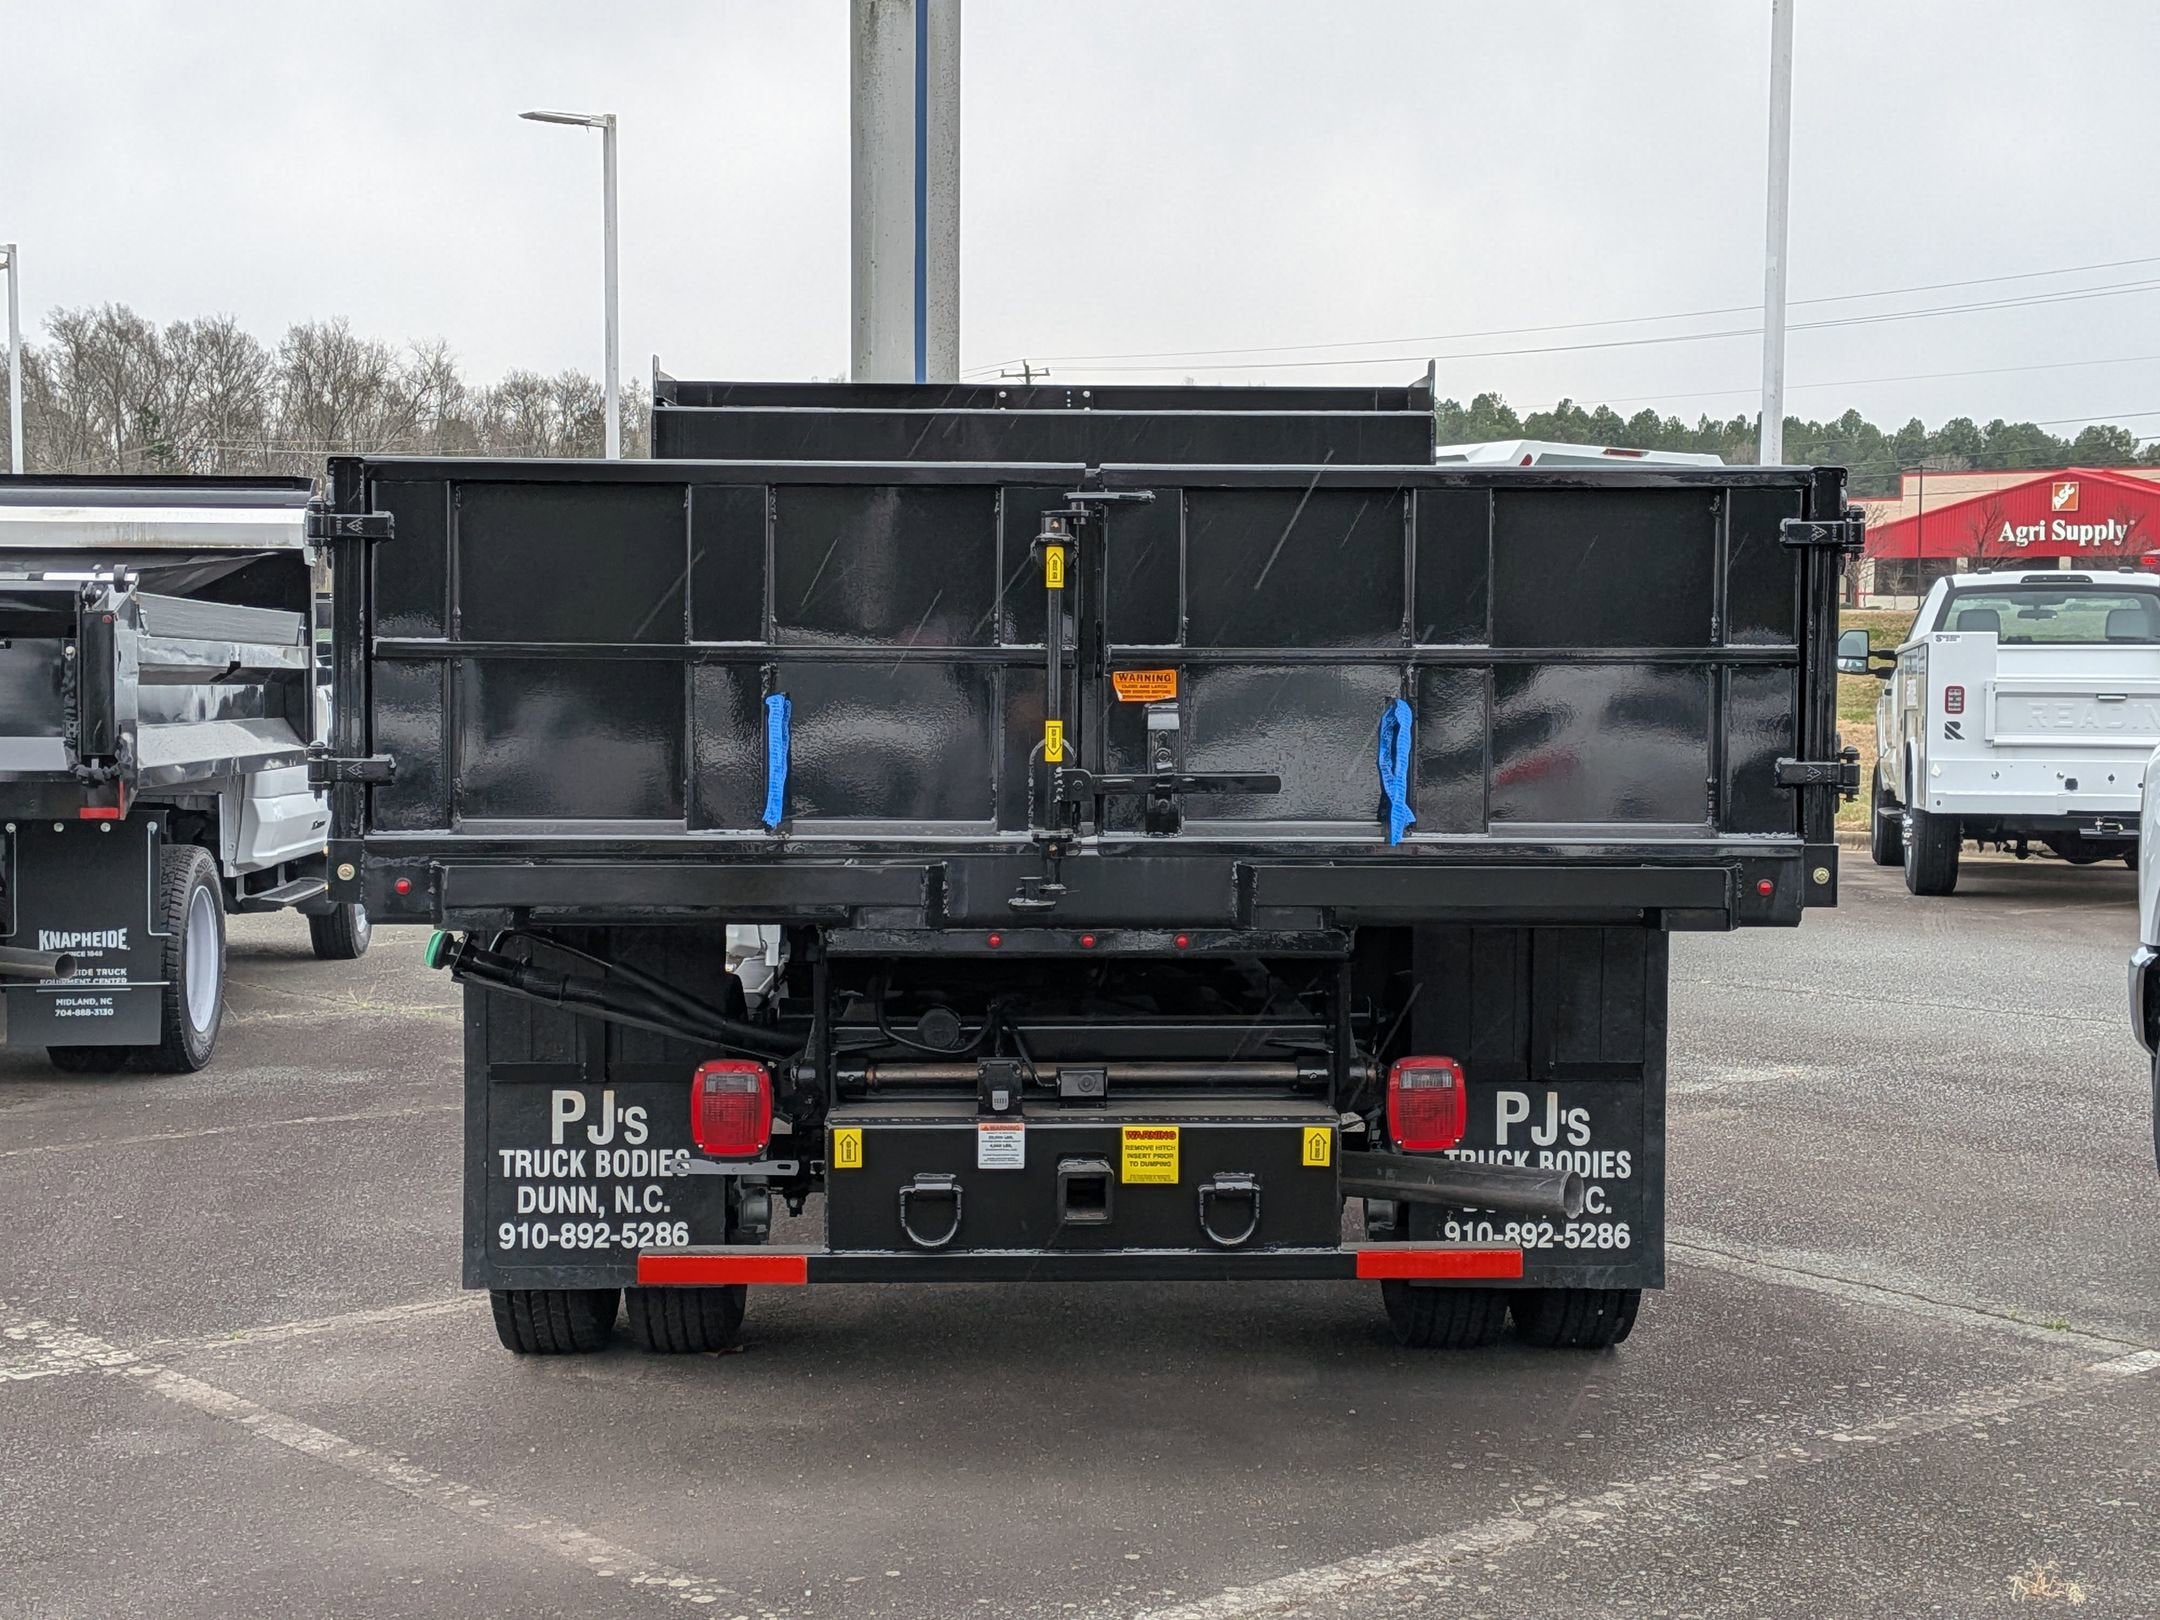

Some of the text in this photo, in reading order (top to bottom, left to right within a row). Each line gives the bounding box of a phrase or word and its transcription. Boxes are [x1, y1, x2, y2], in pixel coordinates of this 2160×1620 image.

[1997, 519, 2128, 547] Agri Supply
[1118, 673, 1171, 682] WARNING
[96, 968, 127, 976] TRUCK
[55, 997, 113, 1006] MIDLAND, NC
[1125, 1131, 1176, 1140] WARNING
[499, 1149, 586, 1178] TRUCK
[1539, 1150, 1631, 1178] BODIES
[518, 1185, 670, 1218] DUNN, N.C.
[499, 1222, 689, 1249] 910-892-5286
[1444, 1221, 1630, 1249] 910-892-5286
